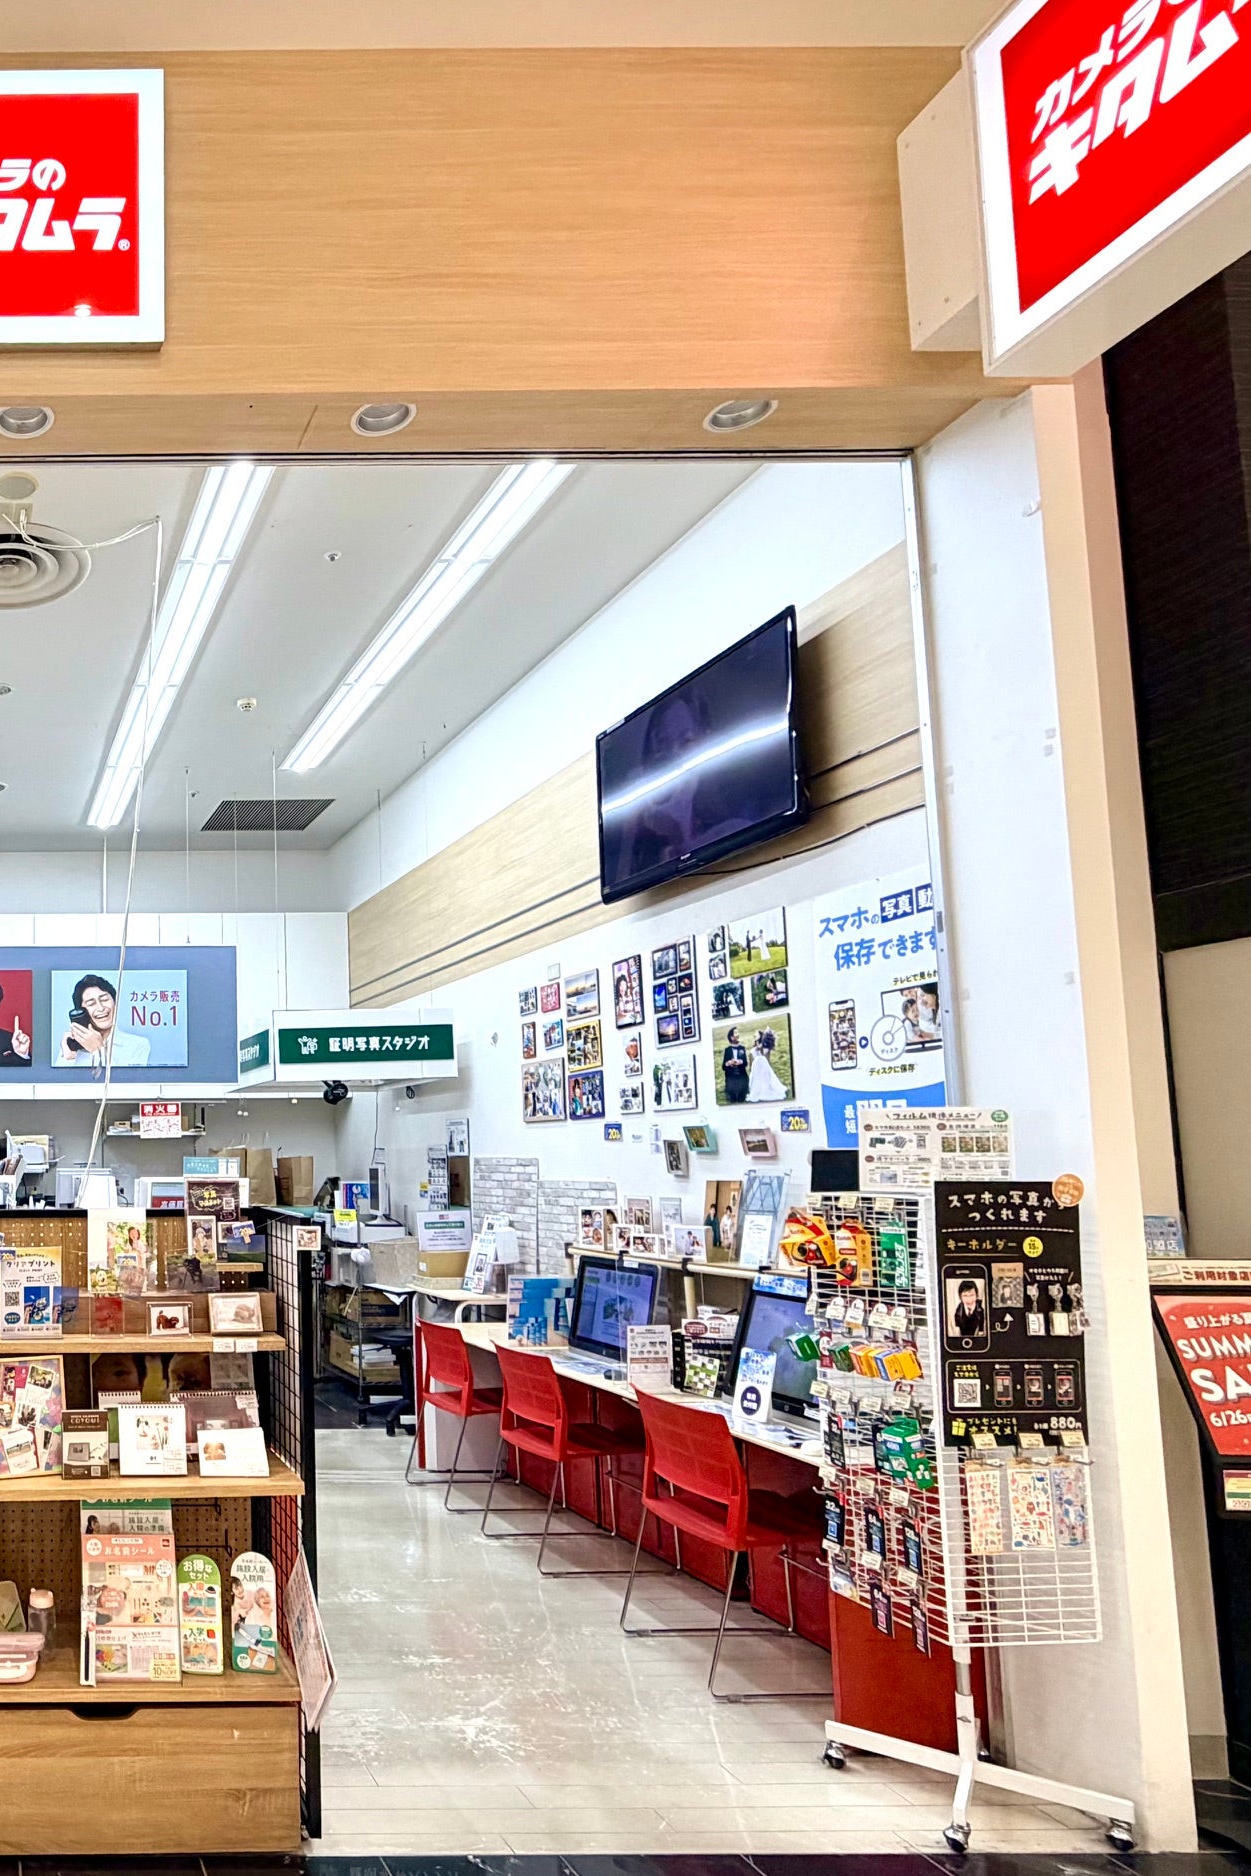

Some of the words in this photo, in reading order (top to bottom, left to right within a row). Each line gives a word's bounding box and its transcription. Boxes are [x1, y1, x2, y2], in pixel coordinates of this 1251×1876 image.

[1031, 0, 1190, 144] カメラ
[1028, 0, 1251, 205] キタム
[130, 990, 180, 1002] カメラ販売
[131, 1005, 178, 1027] No.1
[329, 1035, 430, 1052] 証明写真スタジオ
[948, 1190, 1064, 1210] スマホの写真か
[968, 1207, 1047, 1224] つくれます
[947, 1238, 1018, 1251] キーホルダー
[1182, 1270, 1251, 1281] ご利用対象店
[1190, 1365, 1251, 1403] SA
[103, 1545, 156, 1556] お名前シール
[183, 1559, 213, 1573] お得な
[188, 1571, 210, 1580] セット
